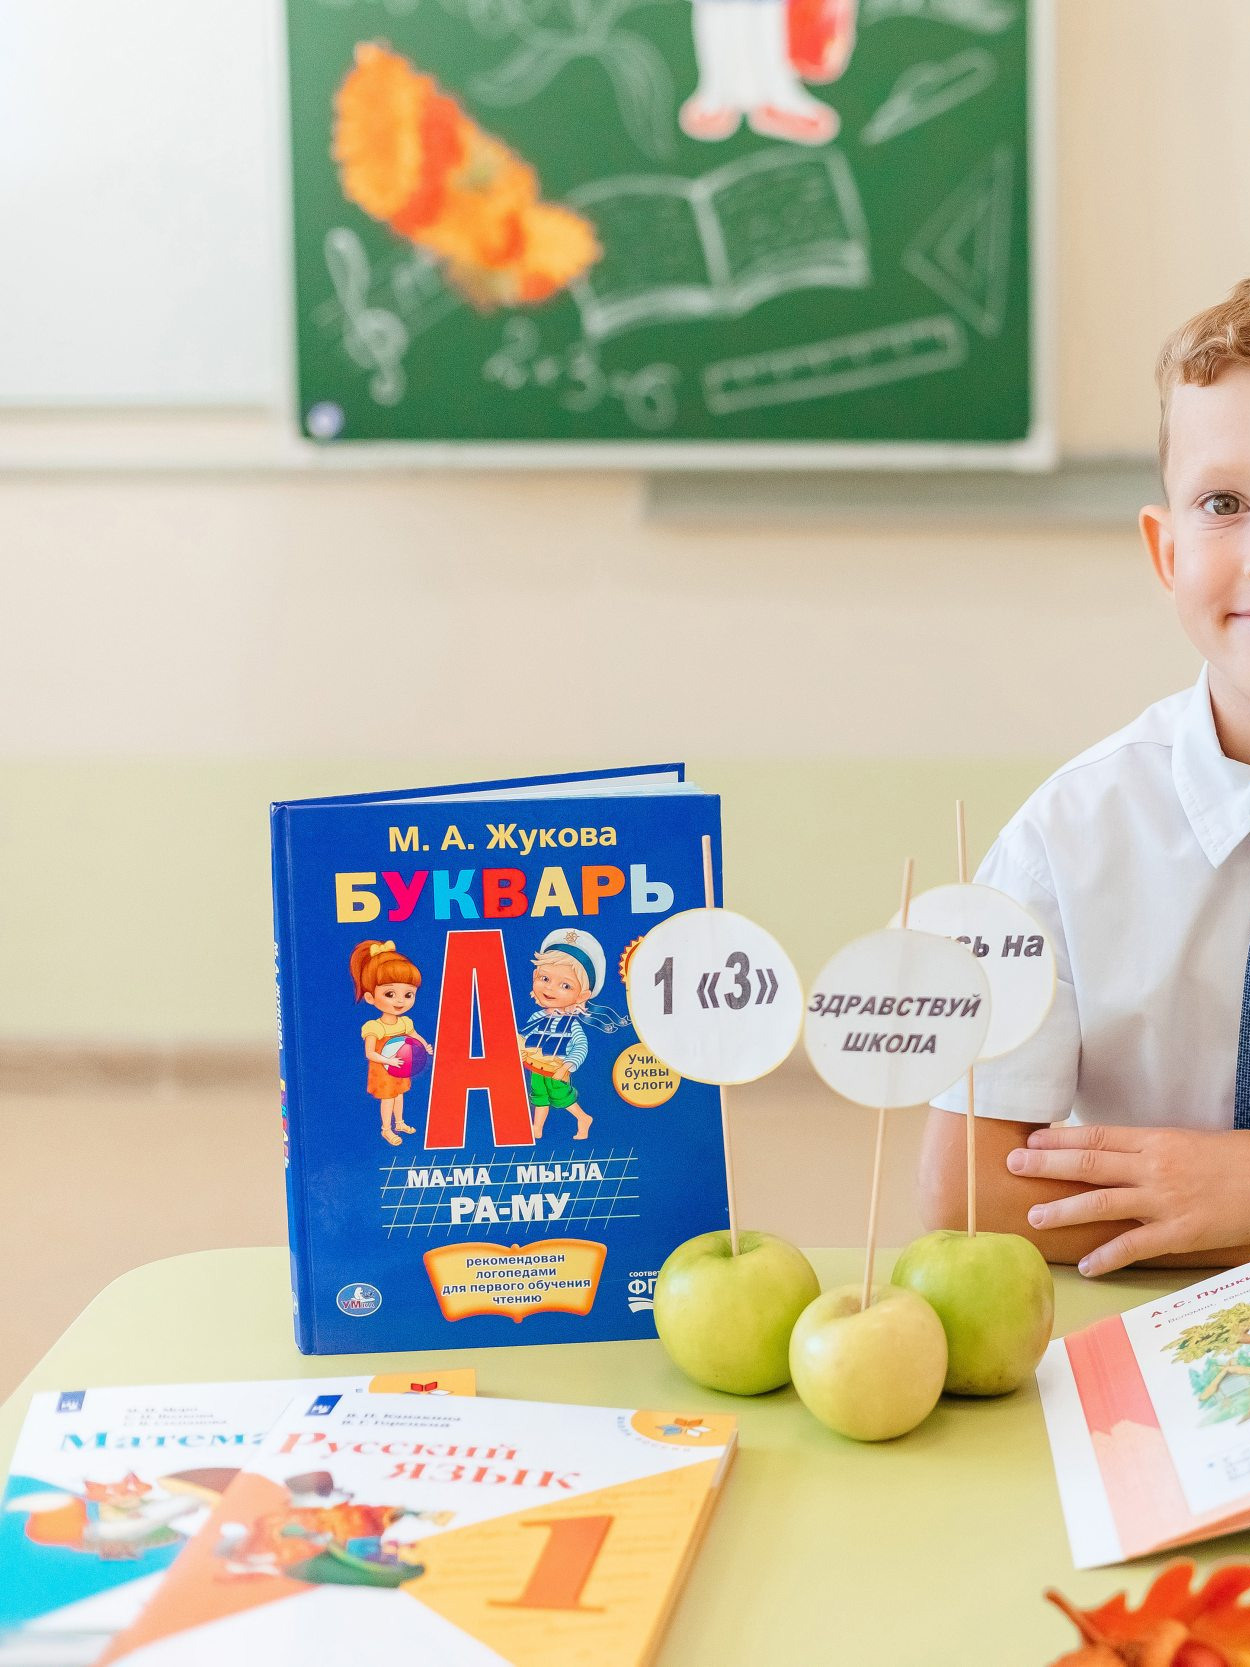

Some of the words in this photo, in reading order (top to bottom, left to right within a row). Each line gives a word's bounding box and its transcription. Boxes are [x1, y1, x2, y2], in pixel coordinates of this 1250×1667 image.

[389, 826, 430, 852] М.
[441, 825, 475, 850] А.
[486, 823, 617, 856] Жукова
[335, 863, 675, 923] БУКВАРЬ
[1001, 935, 1045, 957] на
[654, 957, 674, 1015] 1
[808, 993, 982, 1018] ЗДРАВСТВУЙ
[424, 929, 536, 1150] А
[842, 1032, 937, 1054] ШКОЛА
[621, 1082, 630, 1091] и
[633, 1080, 673, 1091] слоги
[624, 1067, 670, 1080] буквы
[407, 1167, 492, 1188] МА-МА
[516, 1163, 604, 1184] МЫ-ЛА
[450, 1192, 571, 1225] РА-МУ
[466, 1254, 565, 1268] рекомендован
[476, 1267, 556, 1280] логопедами
[442, 1284, 466, 1296] для
[470, 1281, 525, 1294] первого
[528, 1277, 591, 1291] обучения
[492, 1294, 542, 1306] чтению
[277, 1432, 520, 1461] Русский
[487, 1515, 616, 1614] 1
